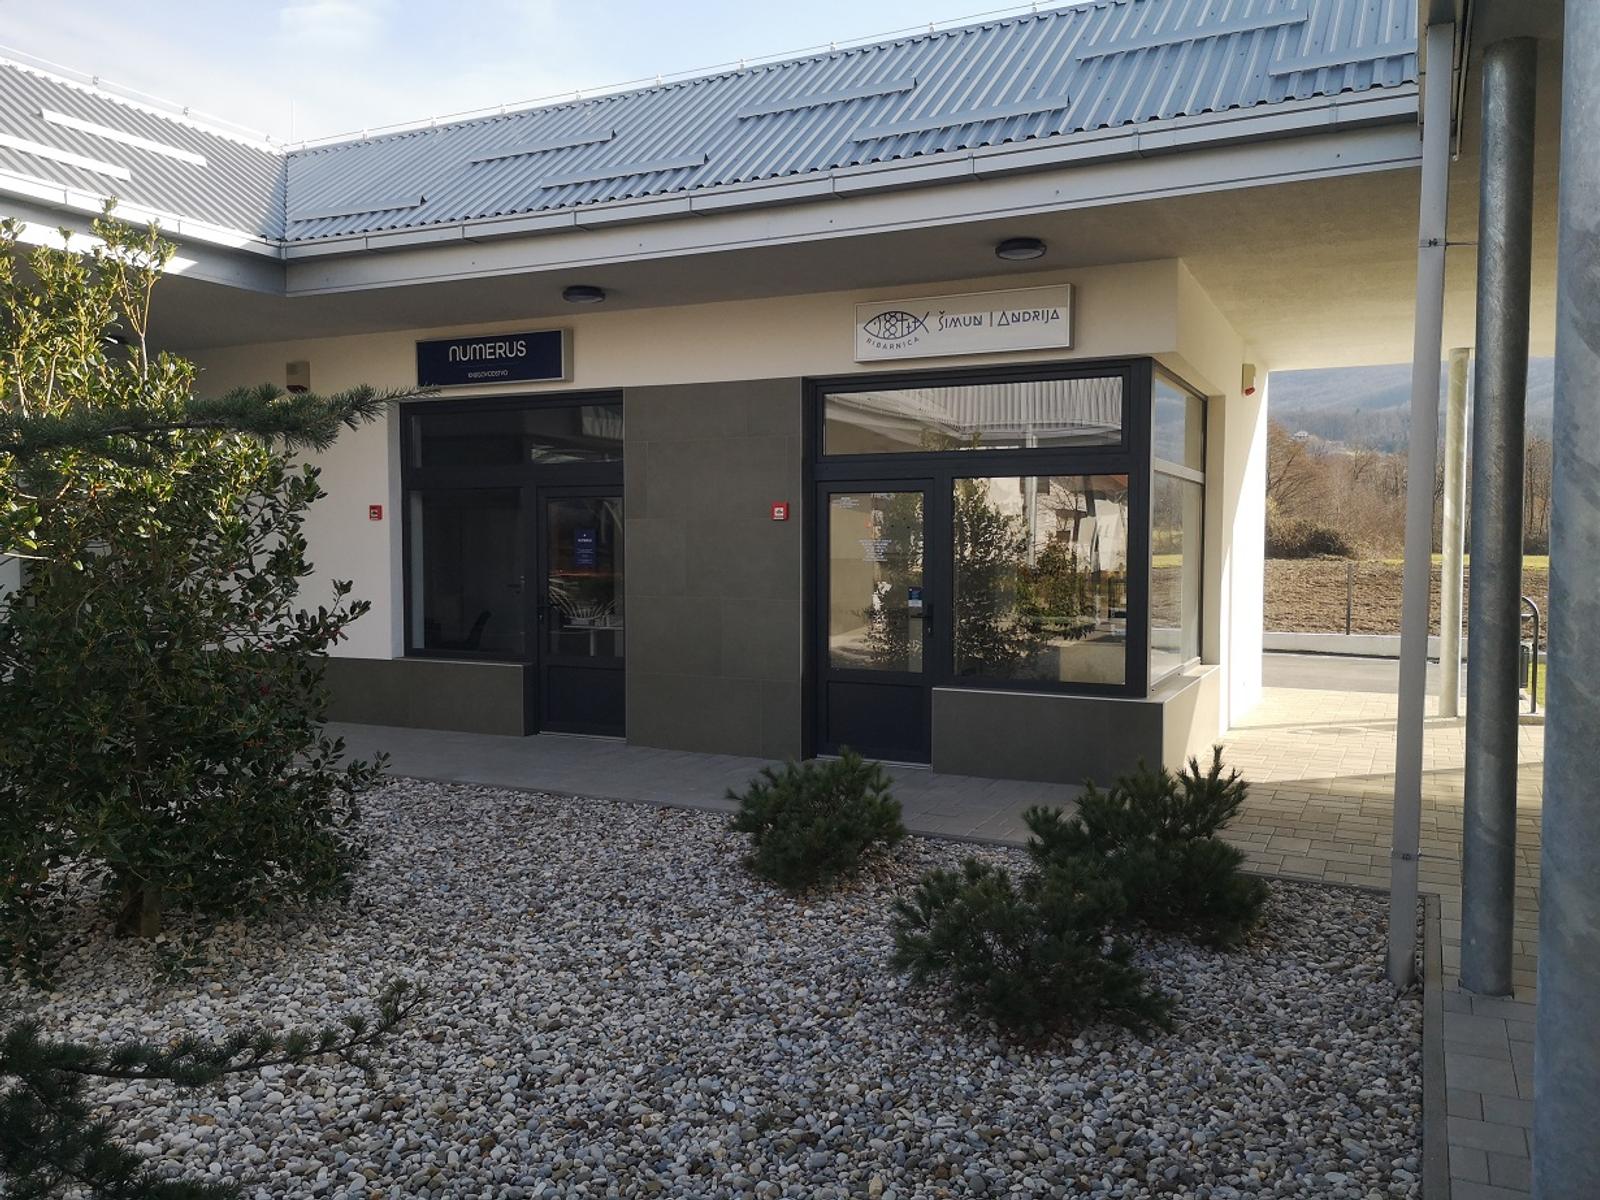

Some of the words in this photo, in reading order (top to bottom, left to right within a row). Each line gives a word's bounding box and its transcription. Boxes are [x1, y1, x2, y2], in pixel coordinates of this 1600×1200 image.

[937, 309, 983, 332] ŠIMUN
[997, 308, 1060, 327] ANDRIJA
[448, 340, 527, 362] NUMERUS
